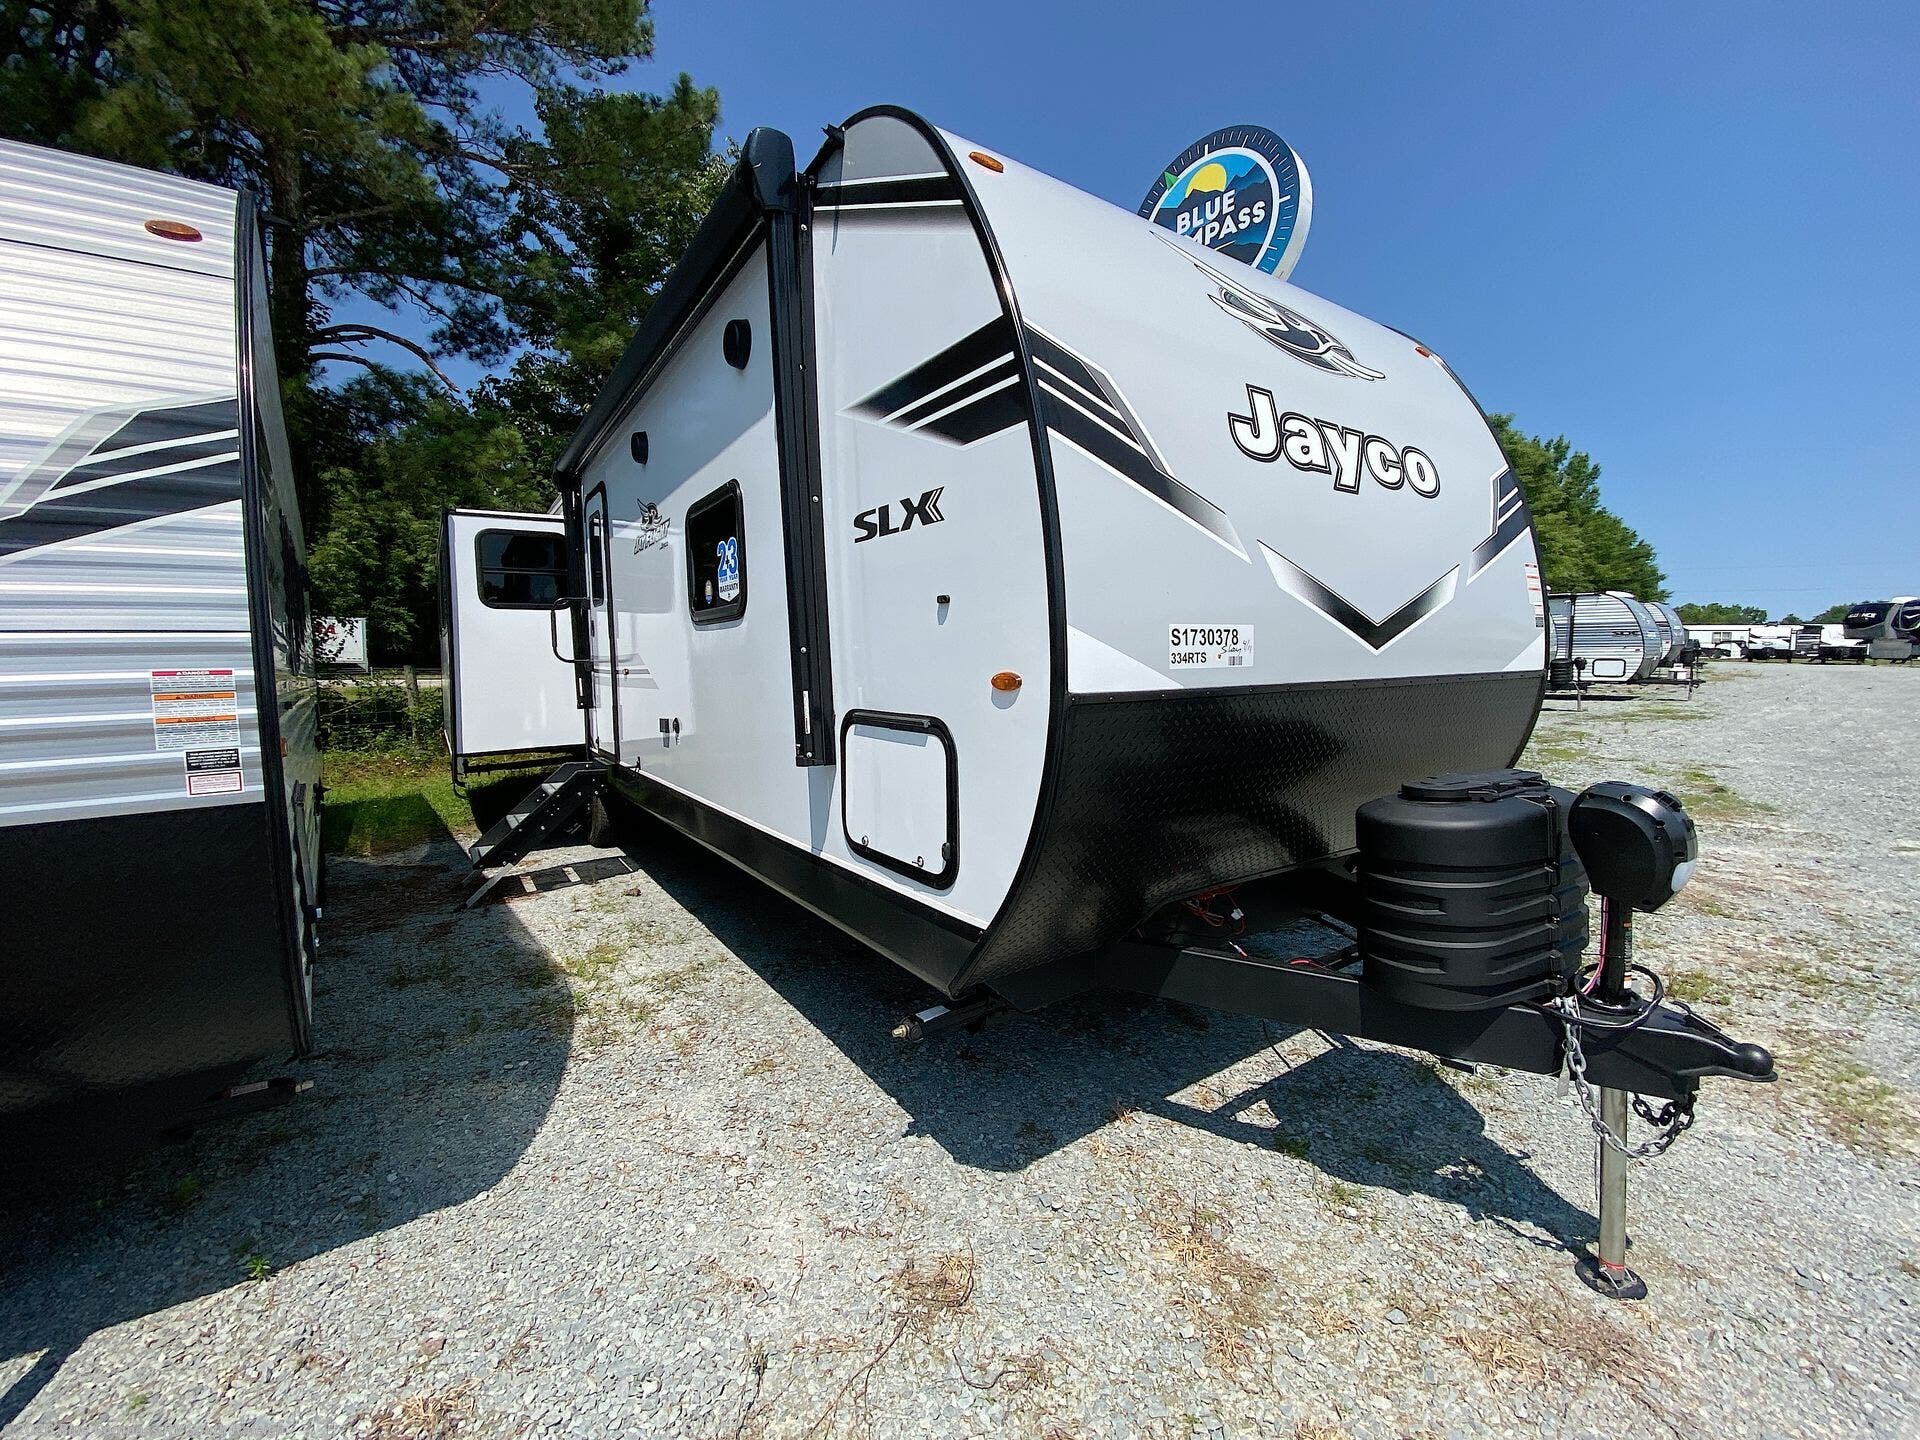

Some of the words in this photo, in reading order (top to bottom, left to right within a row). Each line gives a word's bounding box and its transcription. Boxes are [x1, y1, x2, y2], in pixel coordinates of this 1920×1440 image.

[1177, 190, 1236, 235] BLUE
[1190, 201, 1266, 245] MPASS
[1227, 383, 1441, 499] Jayco
[854, 486, 945, 543] SLX
[1171, 628, 1239, 646] S1730378
[1171, 652, 1207, 664] 334RTS
